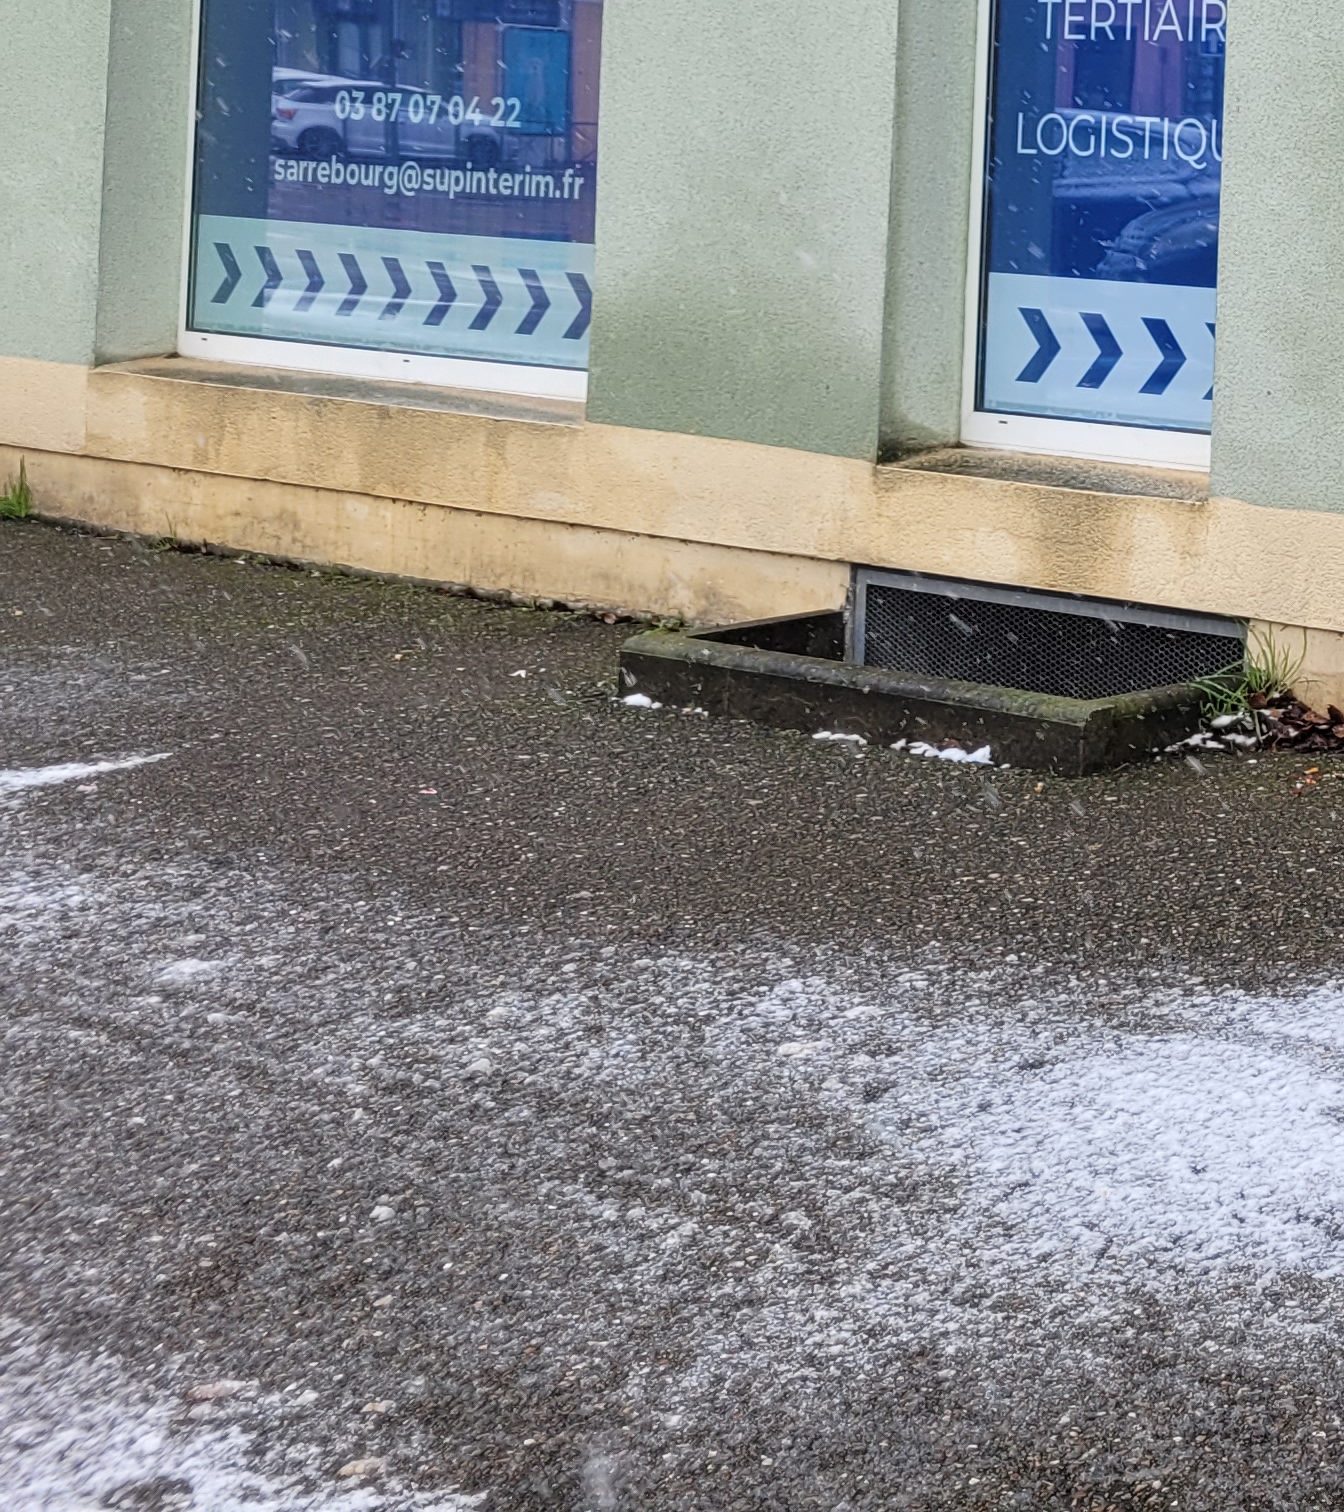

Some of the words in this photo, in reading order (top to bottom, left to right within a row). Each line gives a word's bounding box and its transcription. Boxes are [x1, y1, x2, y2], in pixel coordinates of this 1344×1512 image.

[334, 90, 365, 121] 03
[371, 93, 402, 124] 87
[408, 94, 441, 126] 07
[448, 95, 481, 127] 04
[490, 97, 522, 128] 22
[273, 155, 586, 200] sarrebourg@supinterim.fr
